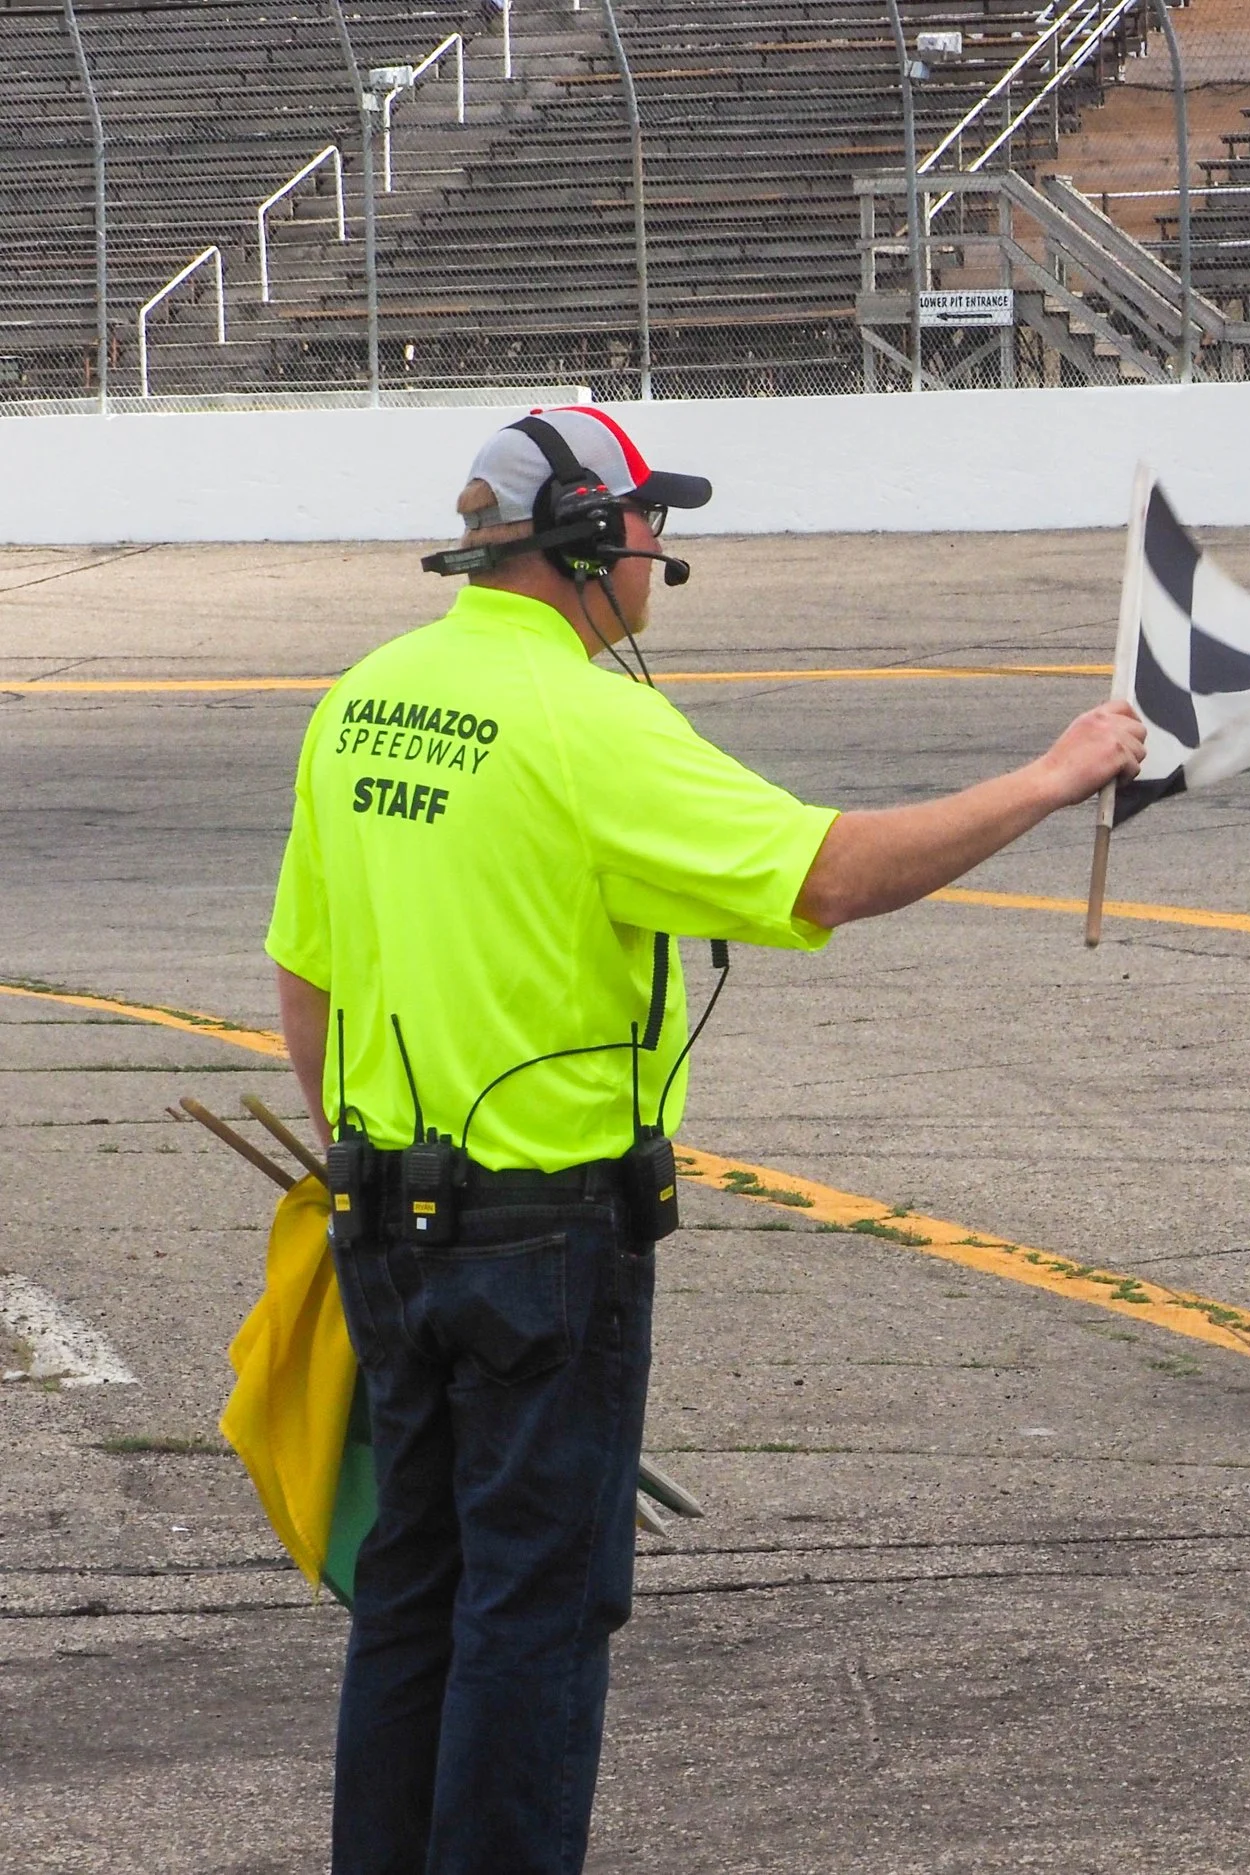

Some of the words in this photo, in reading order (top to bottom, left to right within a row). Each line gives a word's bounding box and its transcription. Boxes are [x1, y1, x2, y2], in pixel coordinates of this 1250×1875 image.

[919, 296, 947, 308] LOWER
[950, 296, 963, 307] PIT
[966, 295, 1009, 307] ENTRANCE
[342, 699, 499, 745] KALAMAZOO
[336, 728, 490, 774] SPEEDWAY
[353, 777, 449, 824] STAFF
